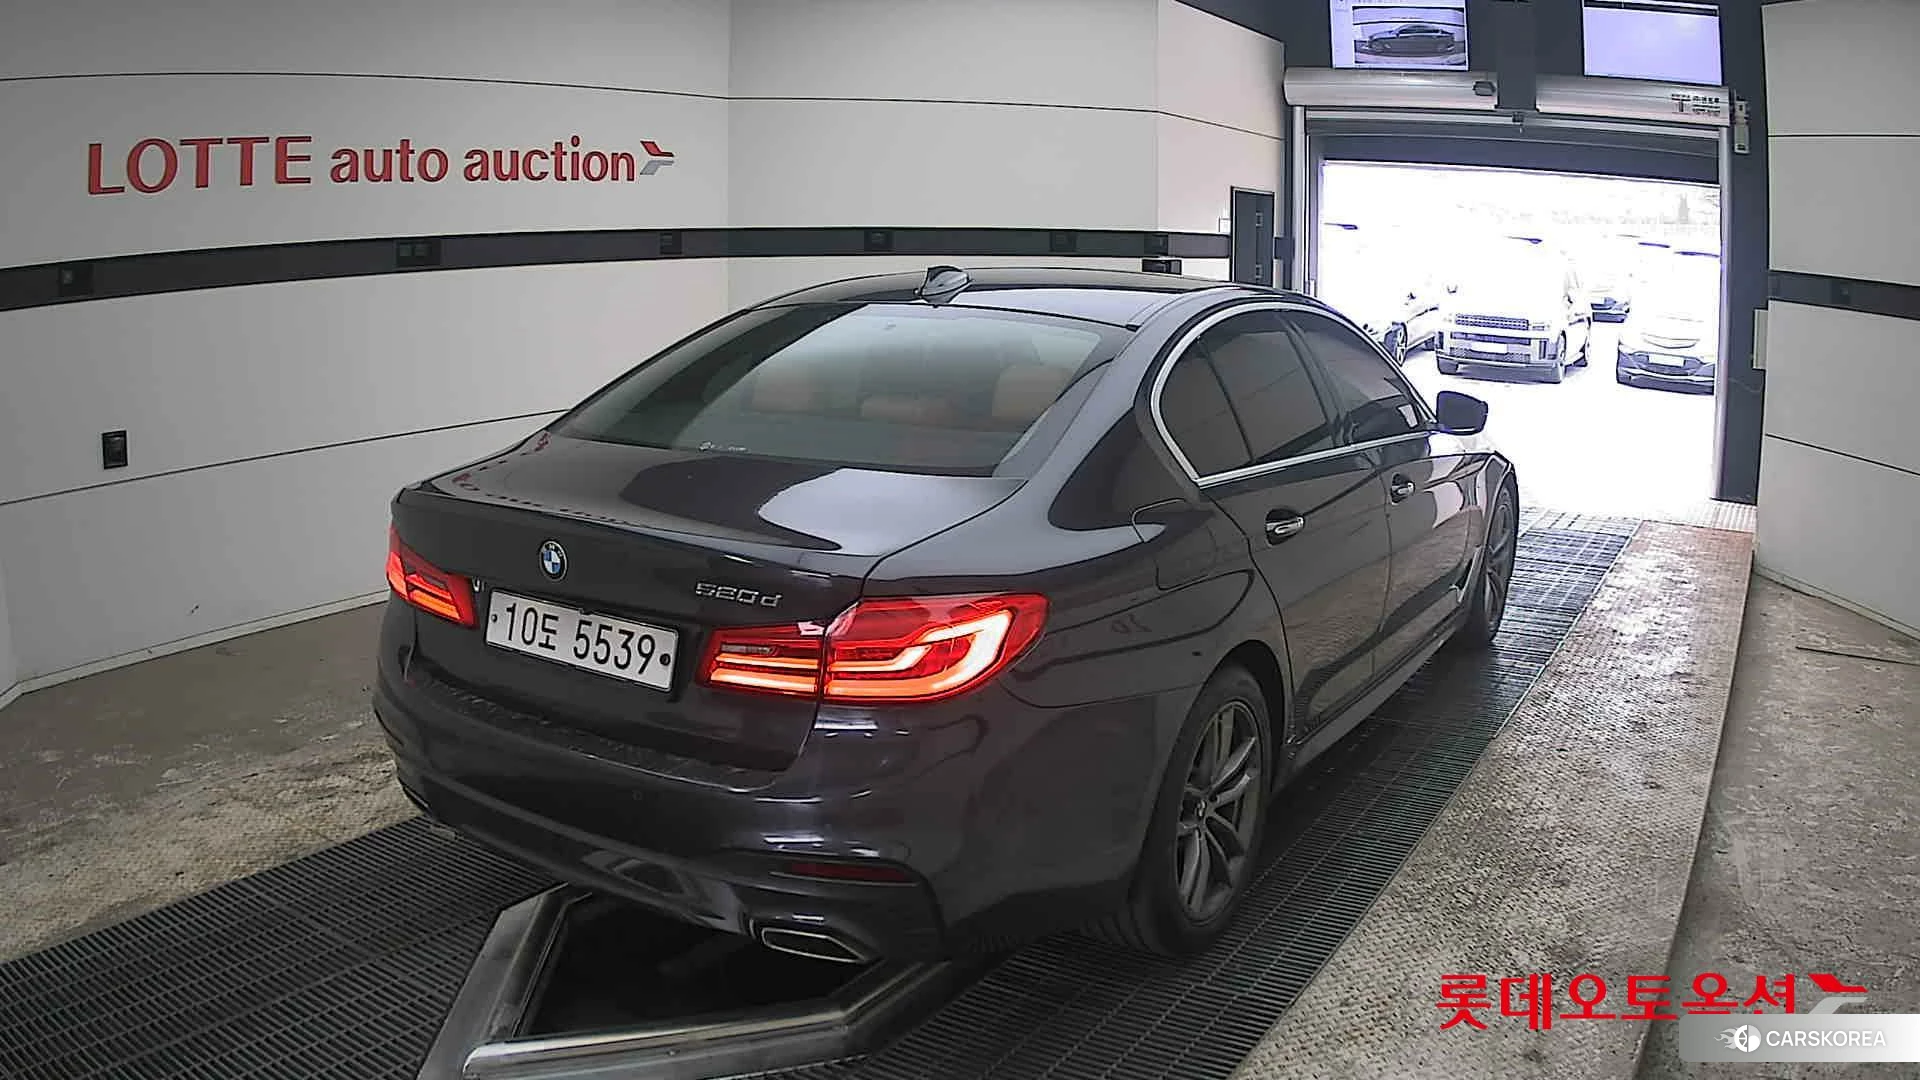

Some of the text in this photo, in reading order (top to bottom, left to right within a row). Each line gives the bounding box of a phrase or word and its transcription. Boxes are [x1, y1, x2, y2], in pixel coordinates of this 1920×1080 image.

[88, 135, 635, 194] LOTTE auto auction
[506, 602, 656, 675] 10도 5539
